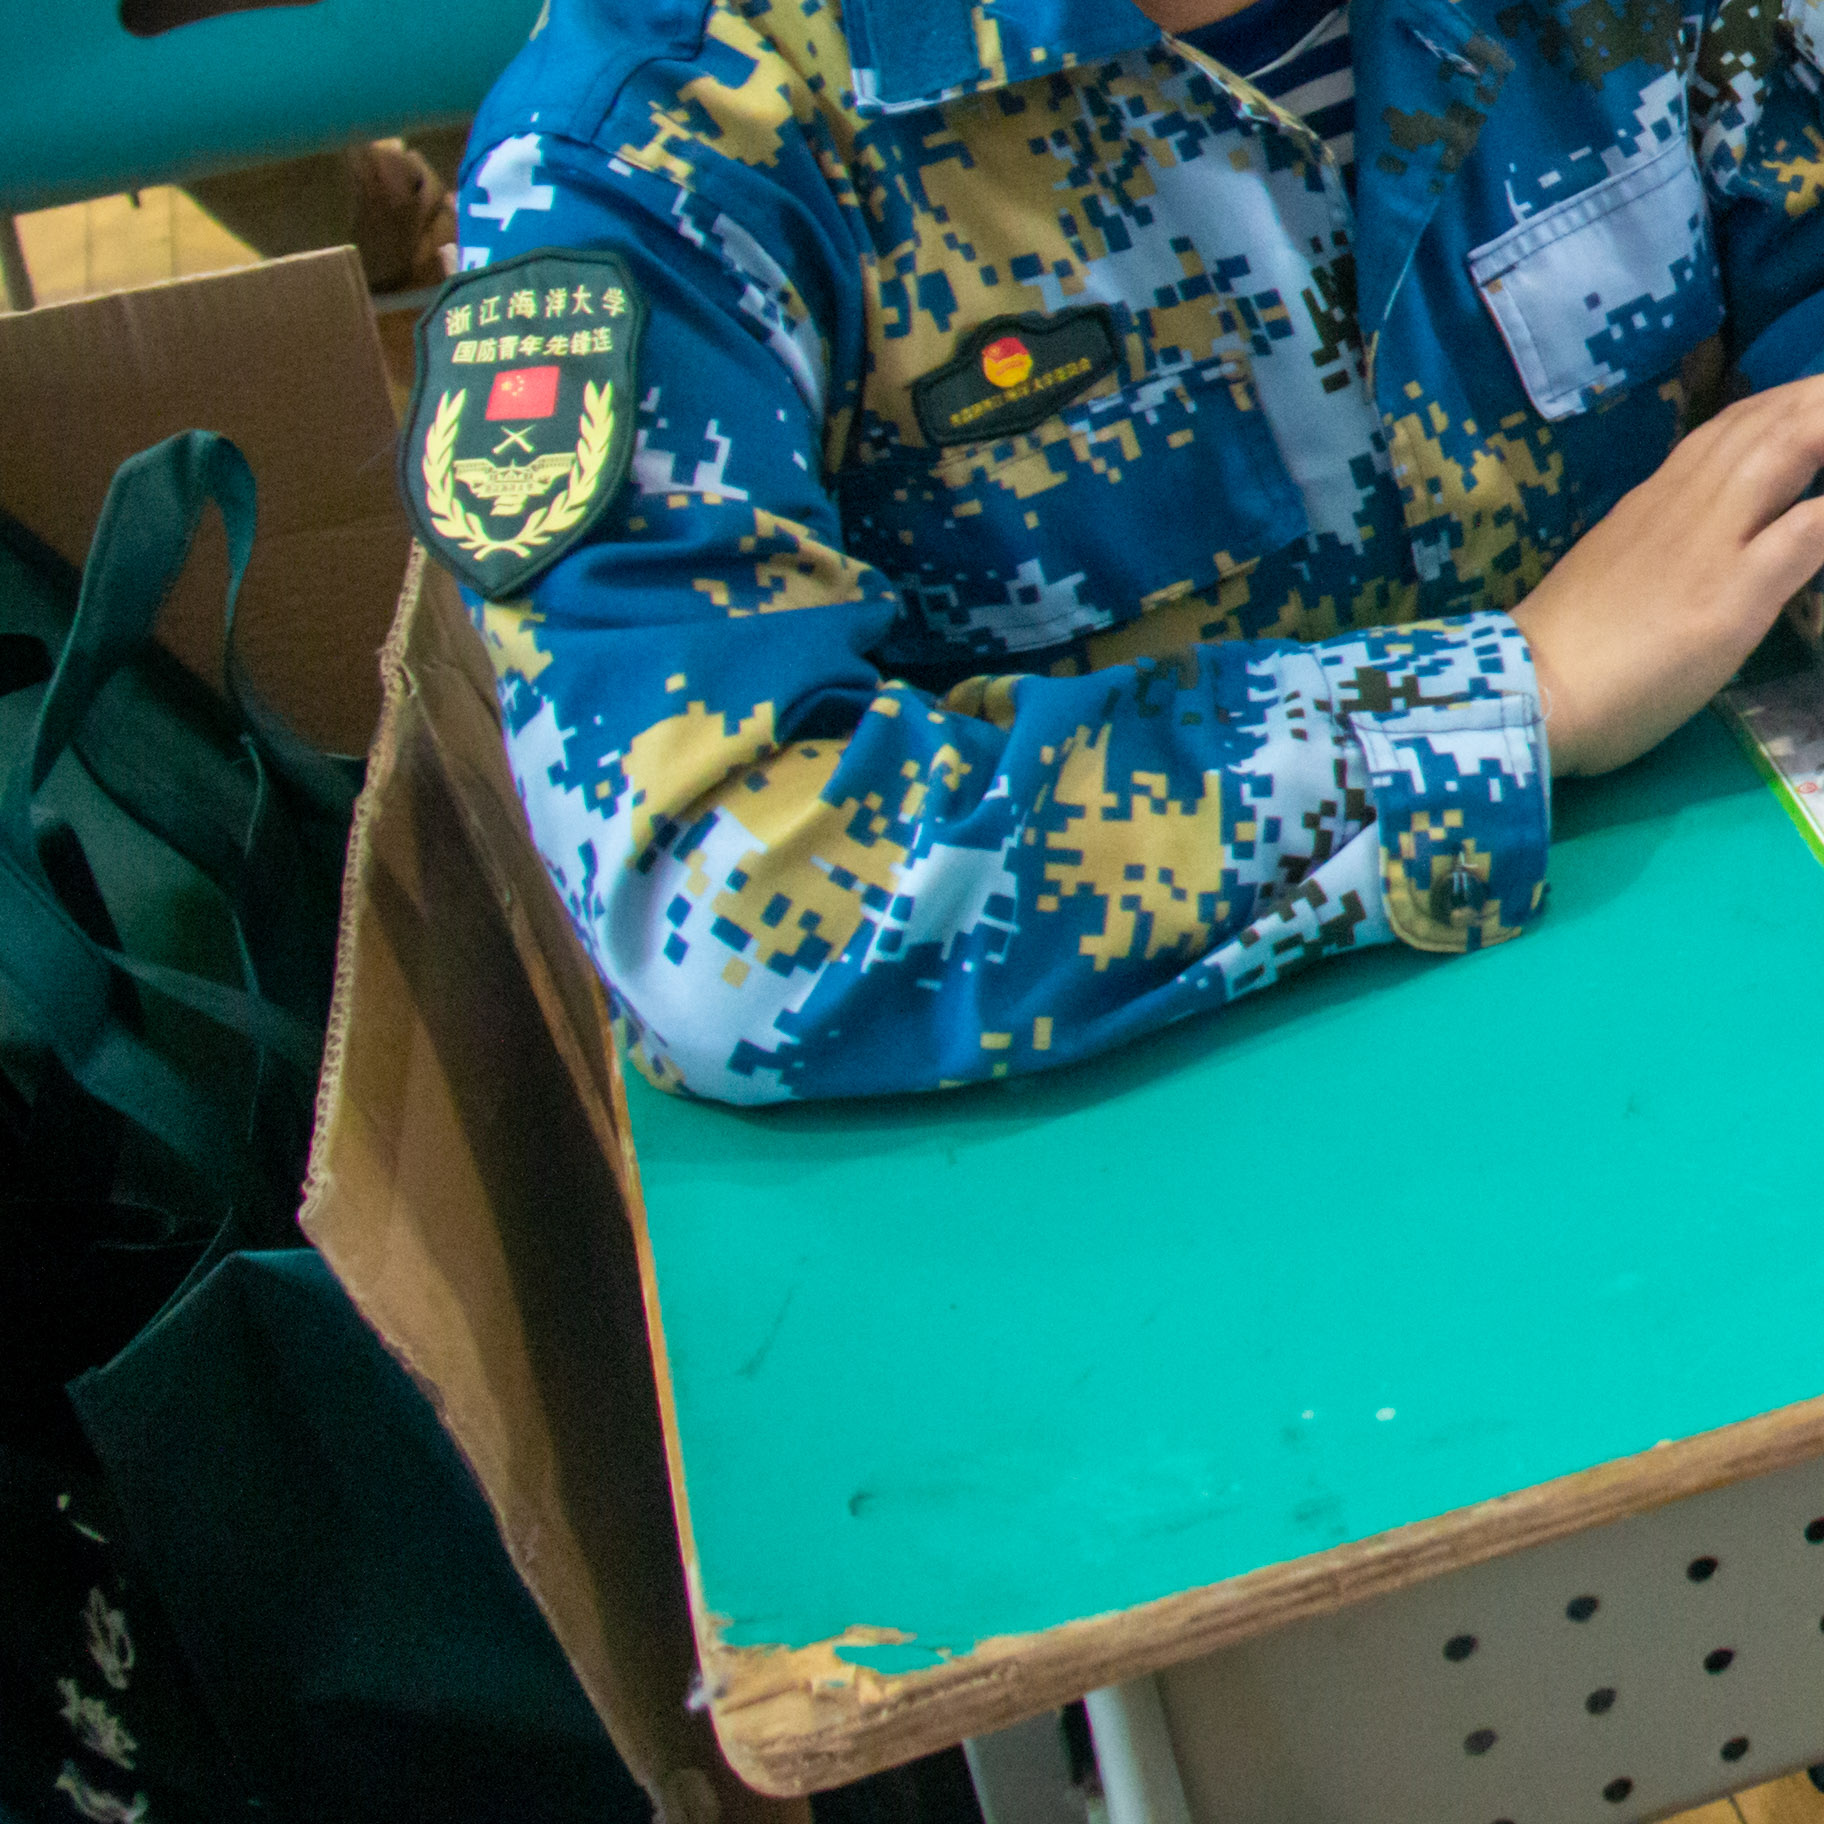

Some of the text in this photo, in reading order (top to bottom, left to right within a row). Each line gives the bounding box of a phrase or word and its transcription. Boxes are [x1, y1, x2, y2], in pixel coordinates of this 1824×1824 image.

[444, 284, 629, 338] 浙江海洋大学
[451, 326, 614, 365] 国防青年先锋连
